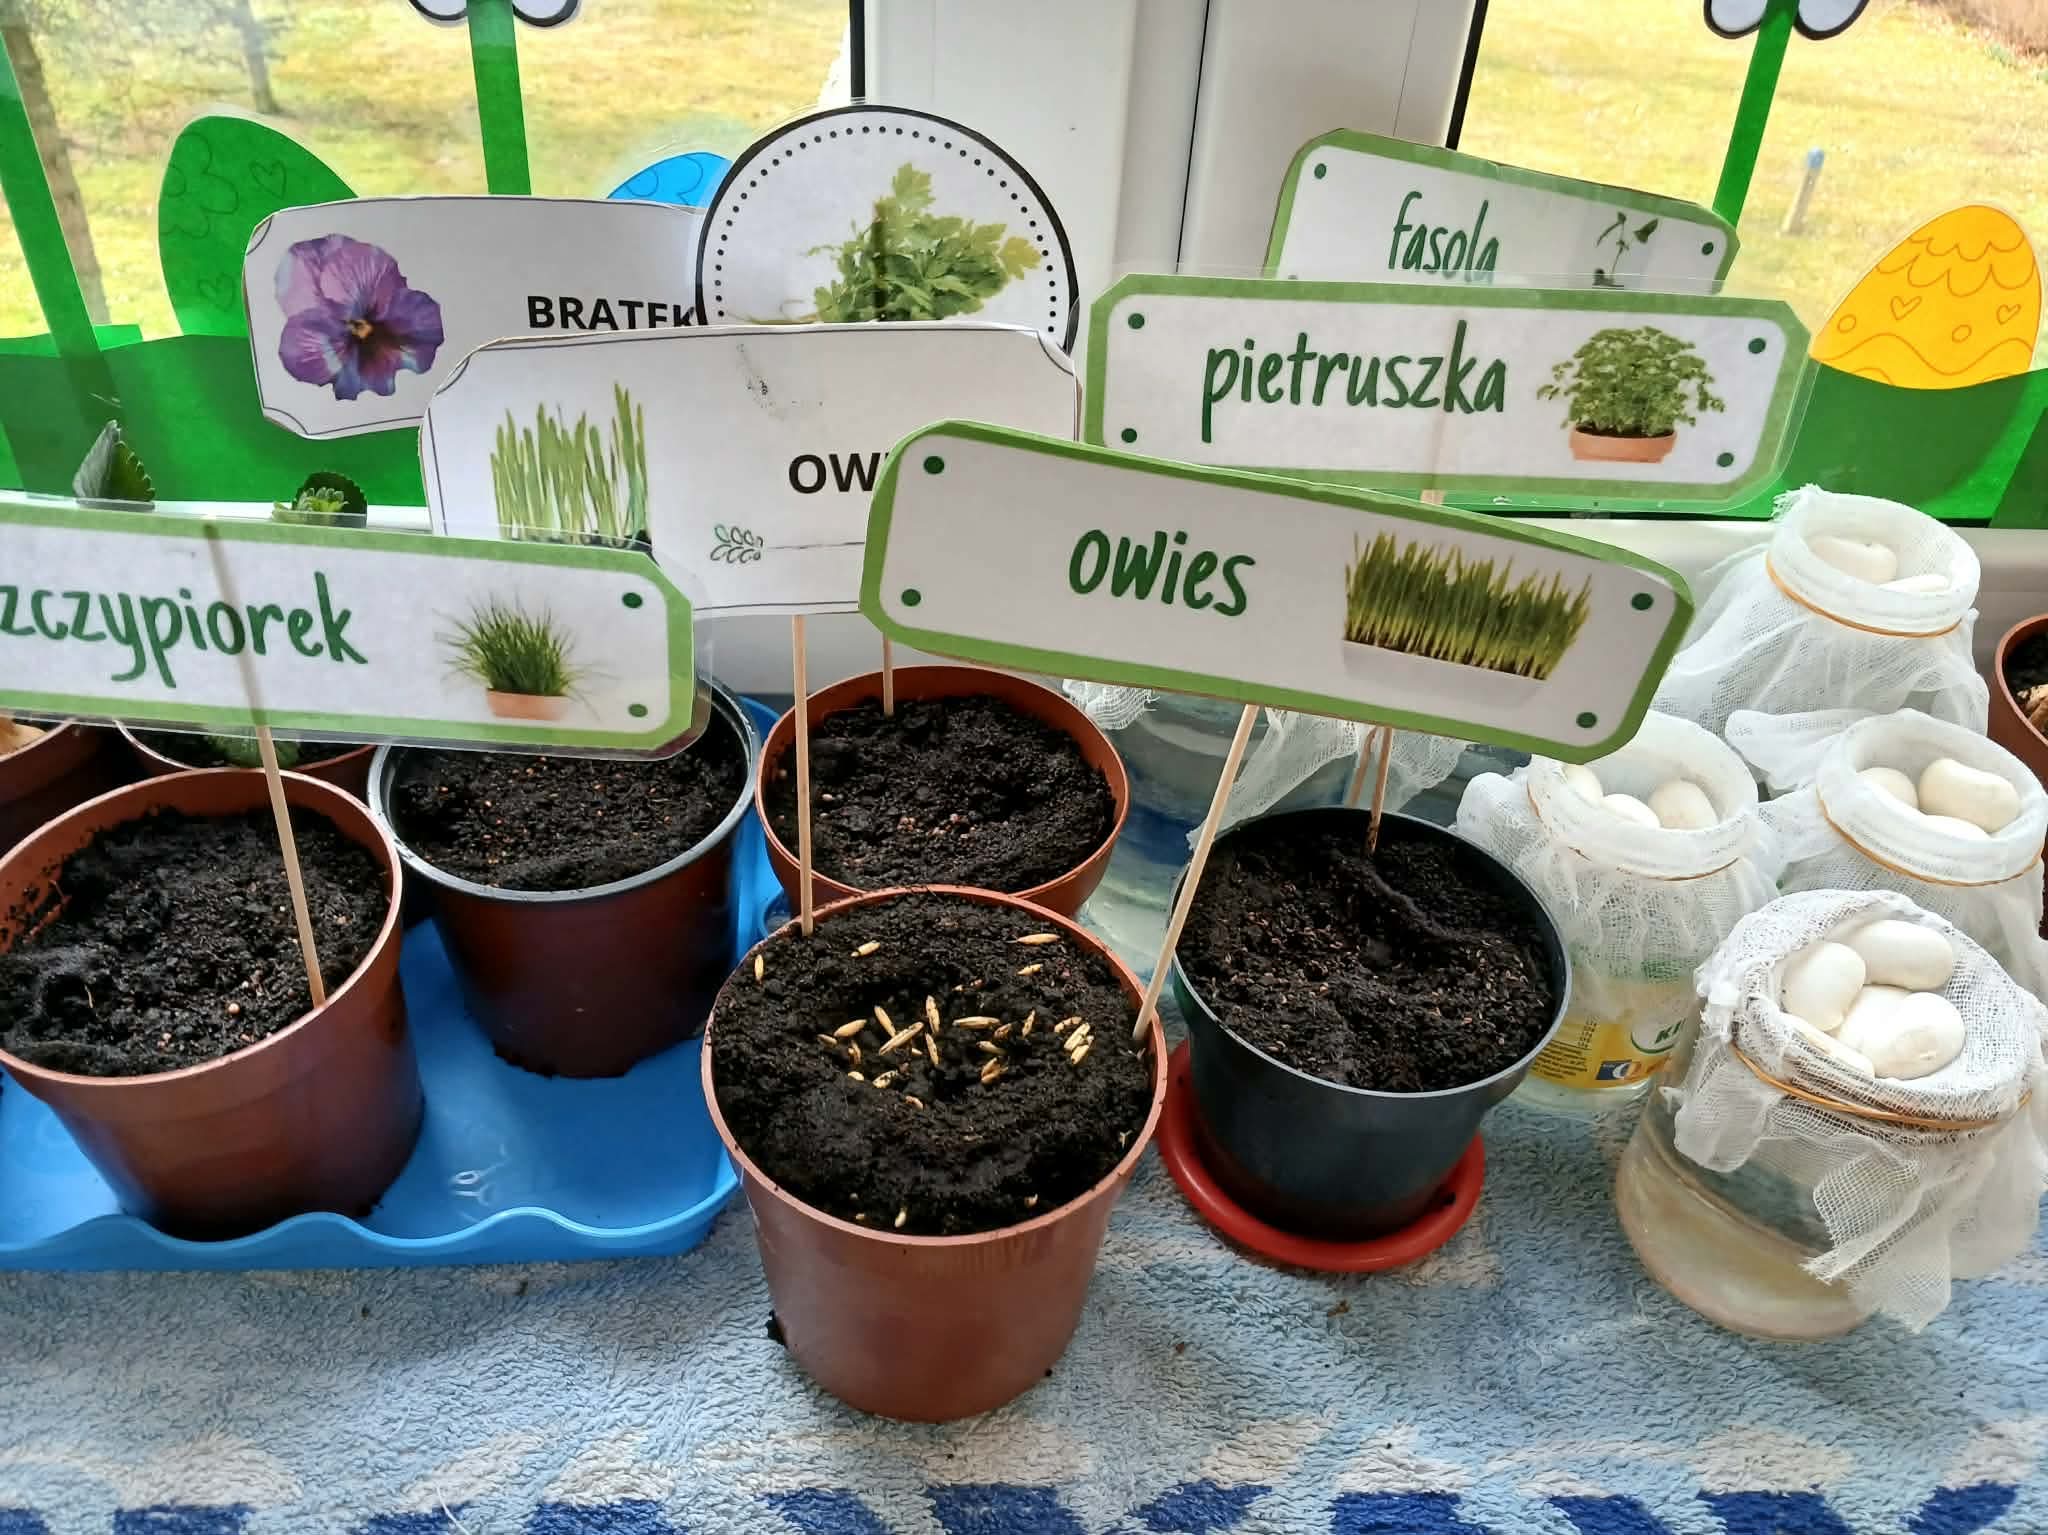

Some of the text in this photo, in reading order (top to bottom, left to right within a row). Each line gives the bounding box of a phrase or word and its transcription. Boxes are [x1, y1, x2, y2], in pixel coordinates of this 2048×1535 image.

[1388, 191, 1499, 284] fasola
[1202, 319, 1506, 443] pietruszka
[788, 452, 889, 494] OW
[1069, 529, 1256, 617] owies
